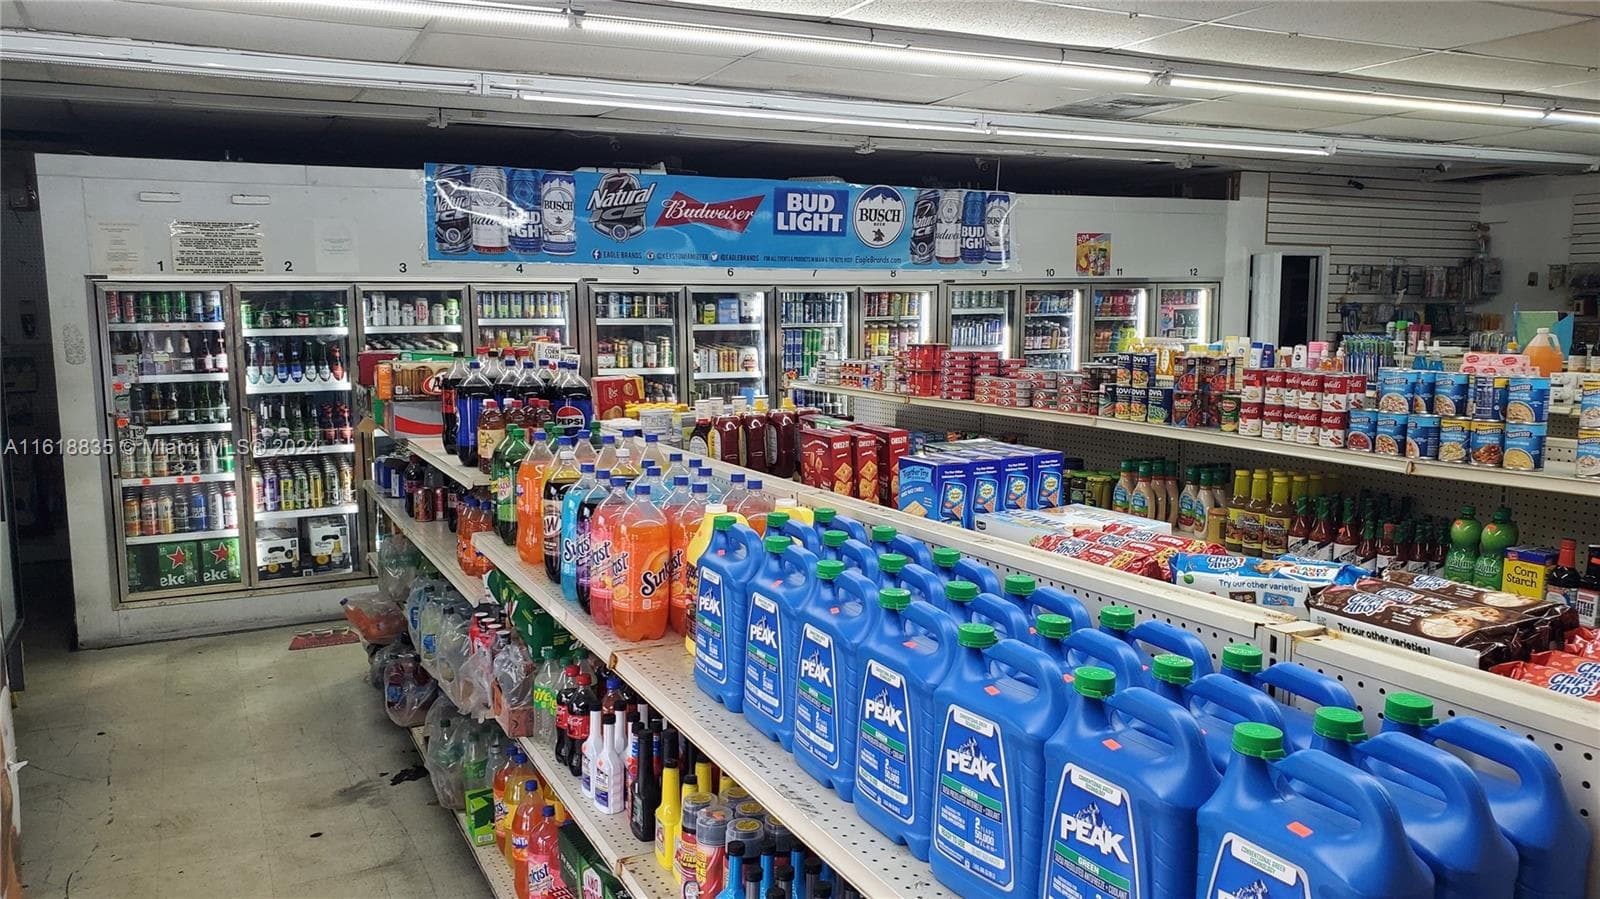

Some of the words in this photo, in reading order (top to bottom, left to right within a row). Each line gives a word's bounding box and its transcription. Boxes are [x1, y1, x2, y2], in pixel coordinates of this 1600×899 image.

[587, 183, 657, 211] Natural
[786, 192, 836, 213] BUD
[544, 201, 573, 211] BUSCH
[661, 199, 755, 221] Budweiser
[589, 206, 647, 223] ICE
[858, 208, 901, 224] BUSCH
[777, 212, 843, 234] LIGHT
[962, 226, 985, 238] BUD
[621, 252, 642, 260] BRANDS
[855, 256, 902, 264] EagleBrands.com
[157, 261, 164, 272] 1
[284, 261, 293, 272] 2
[399, 263, 407, 273] 3
[516, 264, 524, 274] 4
[633, 267, 640, 275] 5
[727, 268, 734, 277] 6
[1046, 268, 1055, 277] 10
[1117, 268, 1123, 276] 11
[1189, 268, 1198, 276] 12
[556, 418, 584, 426] PEPSI
[1208, 556, 1238, 564] Chips
[1513, 565, 1538, 579] Corn
[1219, 580, 1232, 589] Try
[1246, 581, 1268, 590] other
[1269, 584, 1304, 593] varieties!
[1506, 573, 1537, 588] Starch
[699, 596, 721, 617] PEAK
[1349, 593, 1383, 606] Chips
[750, 624, 778, 649] PEAK
[1337, 622, 1351, 634] Try
[1351, 627, 1365, 637] our
[1366, 631, 1389, 643] other
[1390, 638, 1431, 656] varieties!
[800, 658, 833, 688] PEAK
[1550, 673, 1593, 687] Chips
[864, 698, 906, 733] PEAK
[884, 758, 890, 769] 2
[946, 749, 1002, 788] PEAK
[961, 785, 978, 800] GREEN
[975, 816, 981, 830] 2
[974, 831, 995, 847] 50,000
[1061, 812, 1130, 864] PEAK
[1078, 856, 1100, 875] GREEN
[1241, 845, 1271, 866] CONVENTIONAL
[1272, 860, 1286, 873] GREEN
